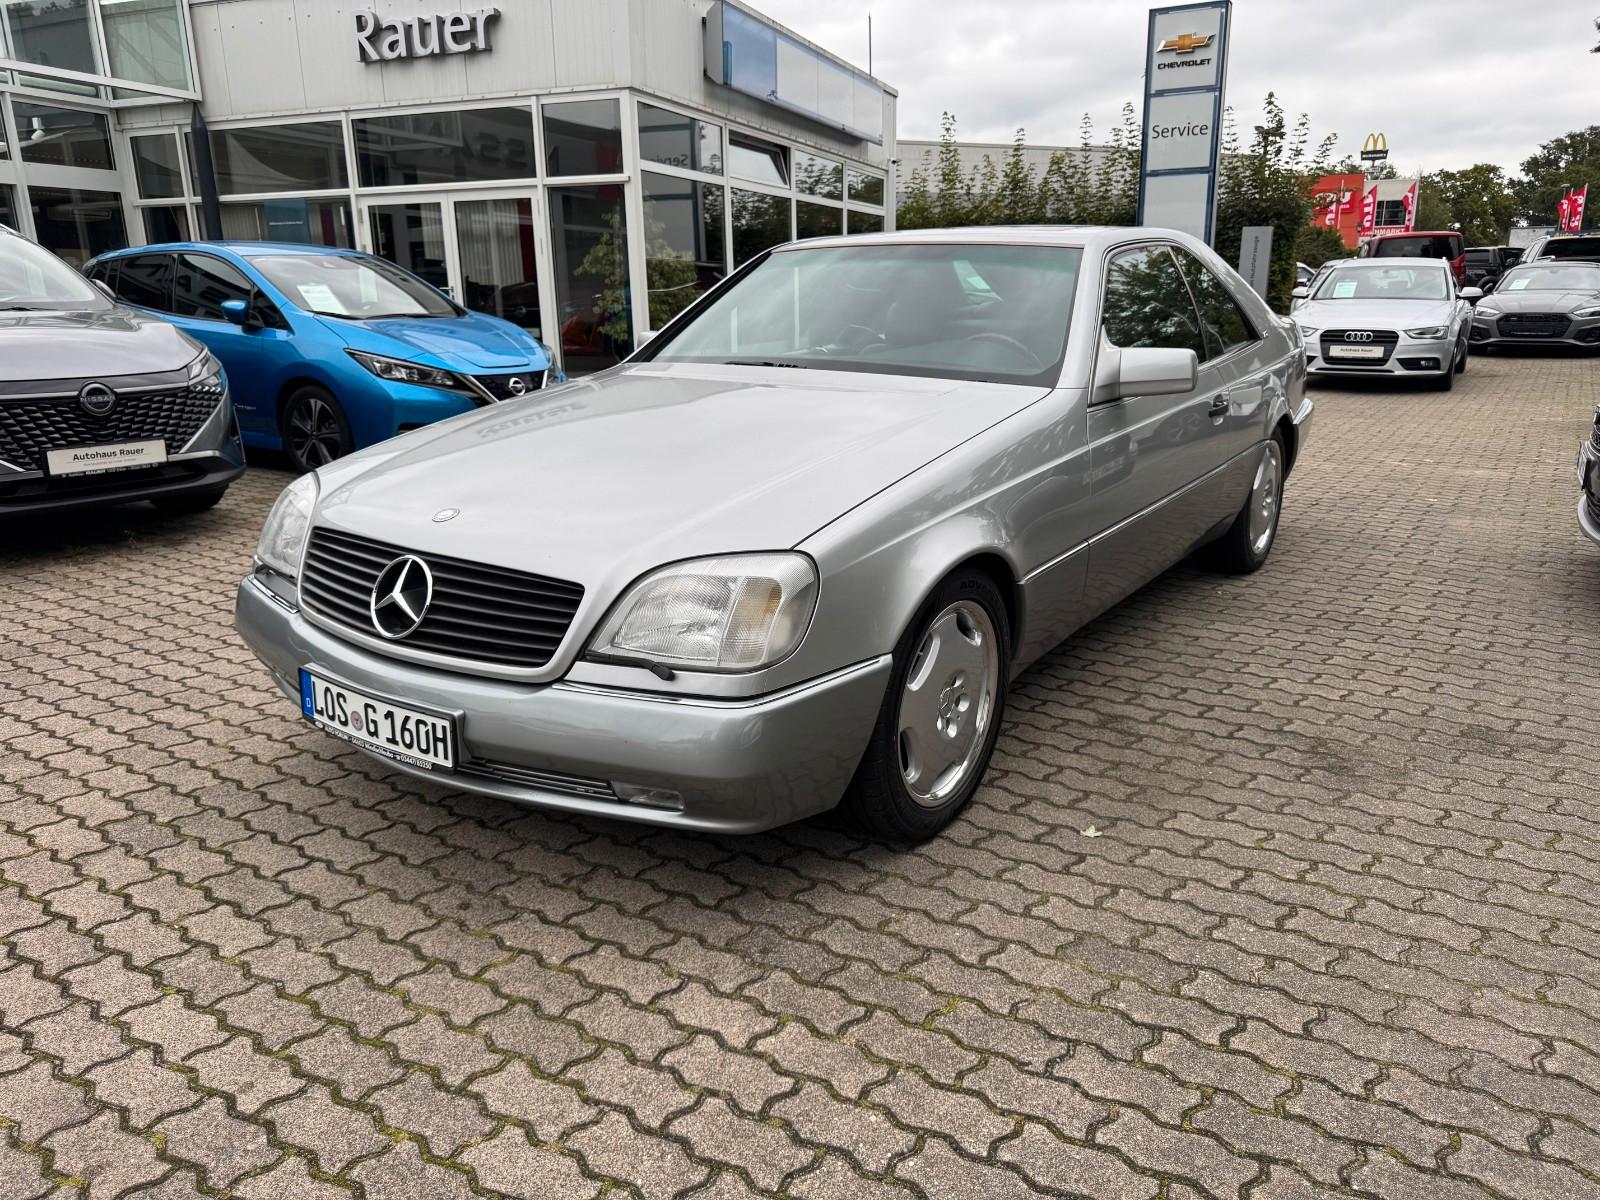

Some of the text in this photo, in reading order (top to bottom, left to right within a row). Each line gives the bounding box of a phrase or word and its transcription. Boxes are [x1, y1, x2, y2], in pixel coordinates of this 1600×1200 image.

[350, 8, 500, 62] Rauer
[1158, 58, 1211, 70] CHEVROLET
[1151, 122, 1208, 139] Service
[73, 447, 145, 461] Autohaus Rauer
[312, 680, 449, 761] LOS G 160H
